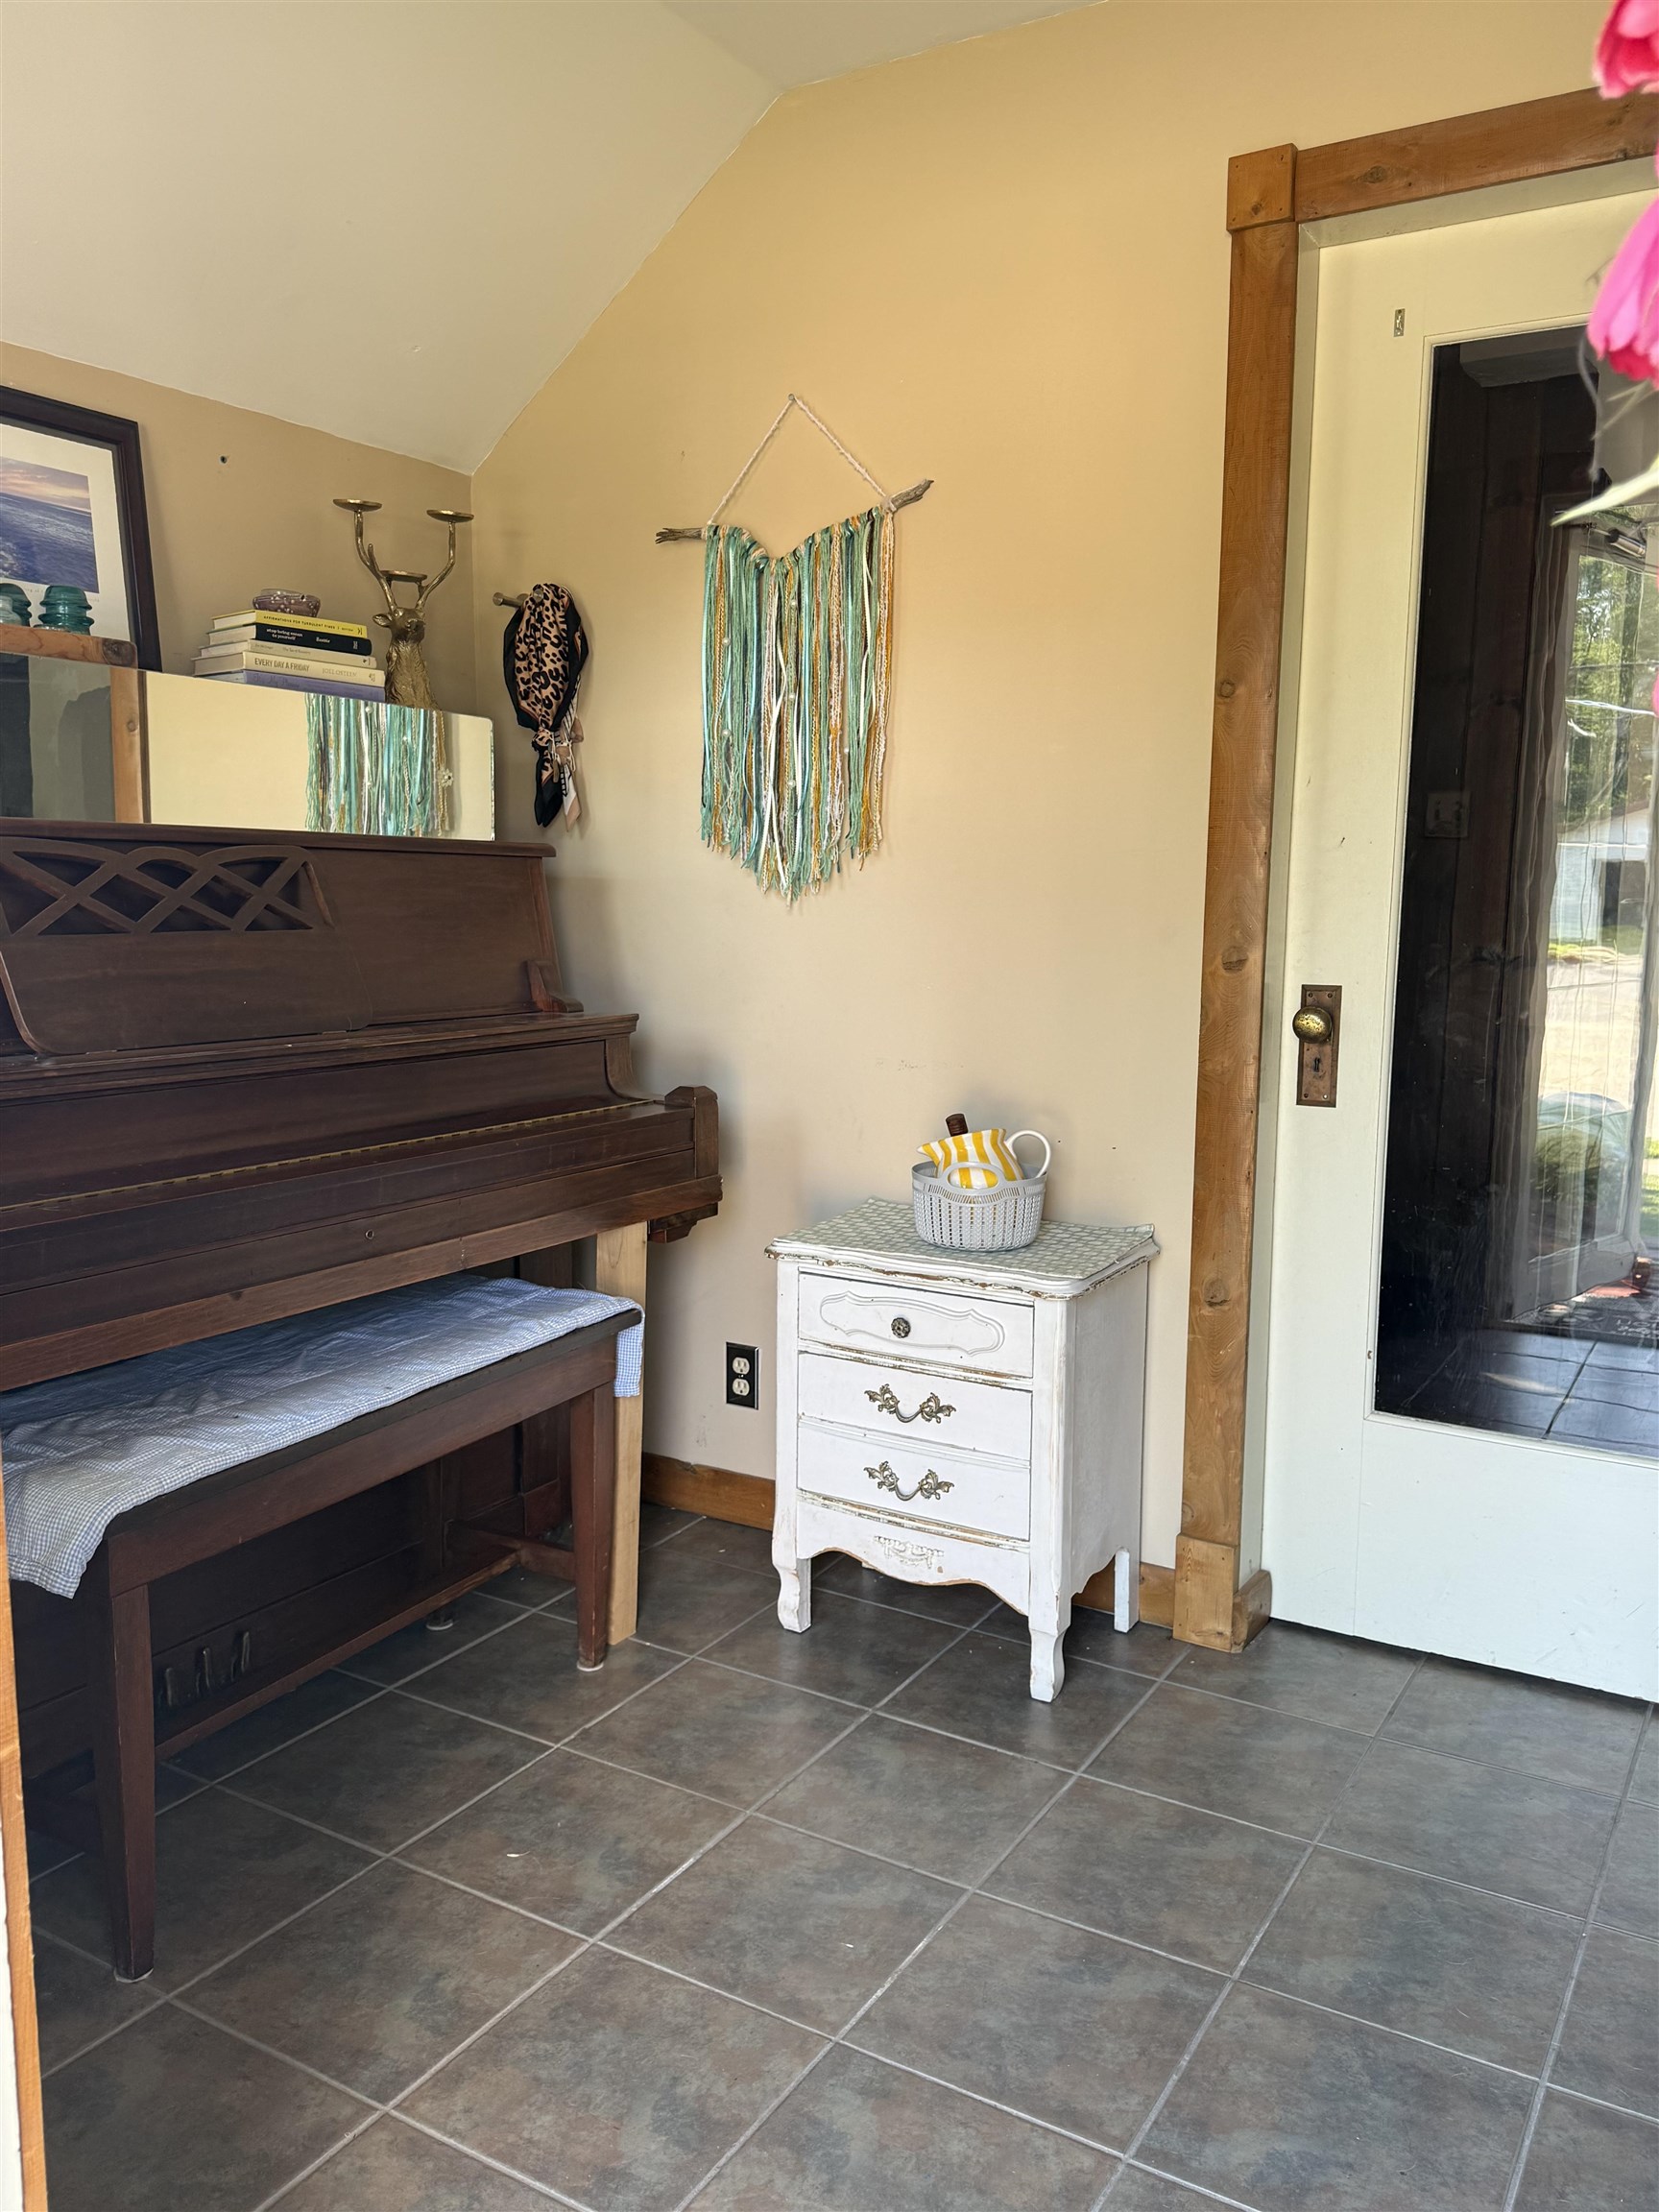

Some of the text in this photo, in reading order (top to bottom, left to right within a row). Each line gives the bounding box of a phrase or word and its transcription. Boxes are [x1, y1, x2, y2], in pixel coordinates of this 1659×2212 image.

[254, 658, 274, 667] EVERY
[274, 661, 285, 669] DAY
[290, 662, 310, 672] FRIDAY
